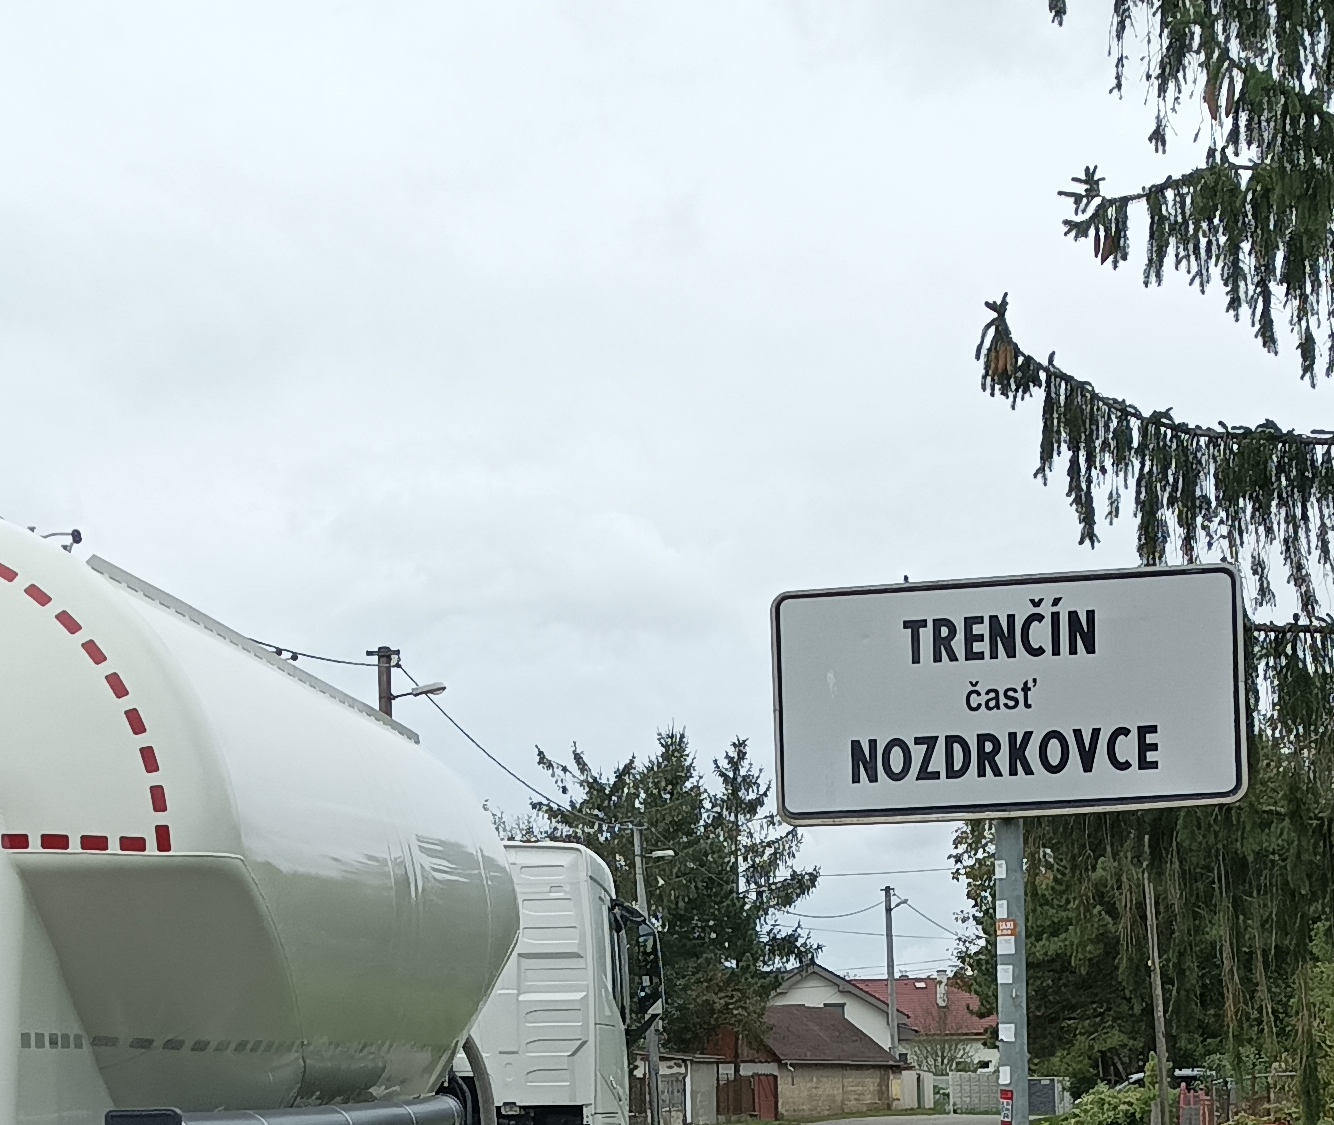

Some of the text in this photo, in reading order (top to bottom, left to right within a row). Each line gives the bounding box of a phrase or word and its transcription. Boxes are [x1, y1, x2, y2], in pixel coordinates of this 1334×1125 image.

[903, 597, 1097, 665] TRENČÍN
[965, 678, 1039, 712] časť
[850, 724, 1160, 784] NOZDRKOVCE
